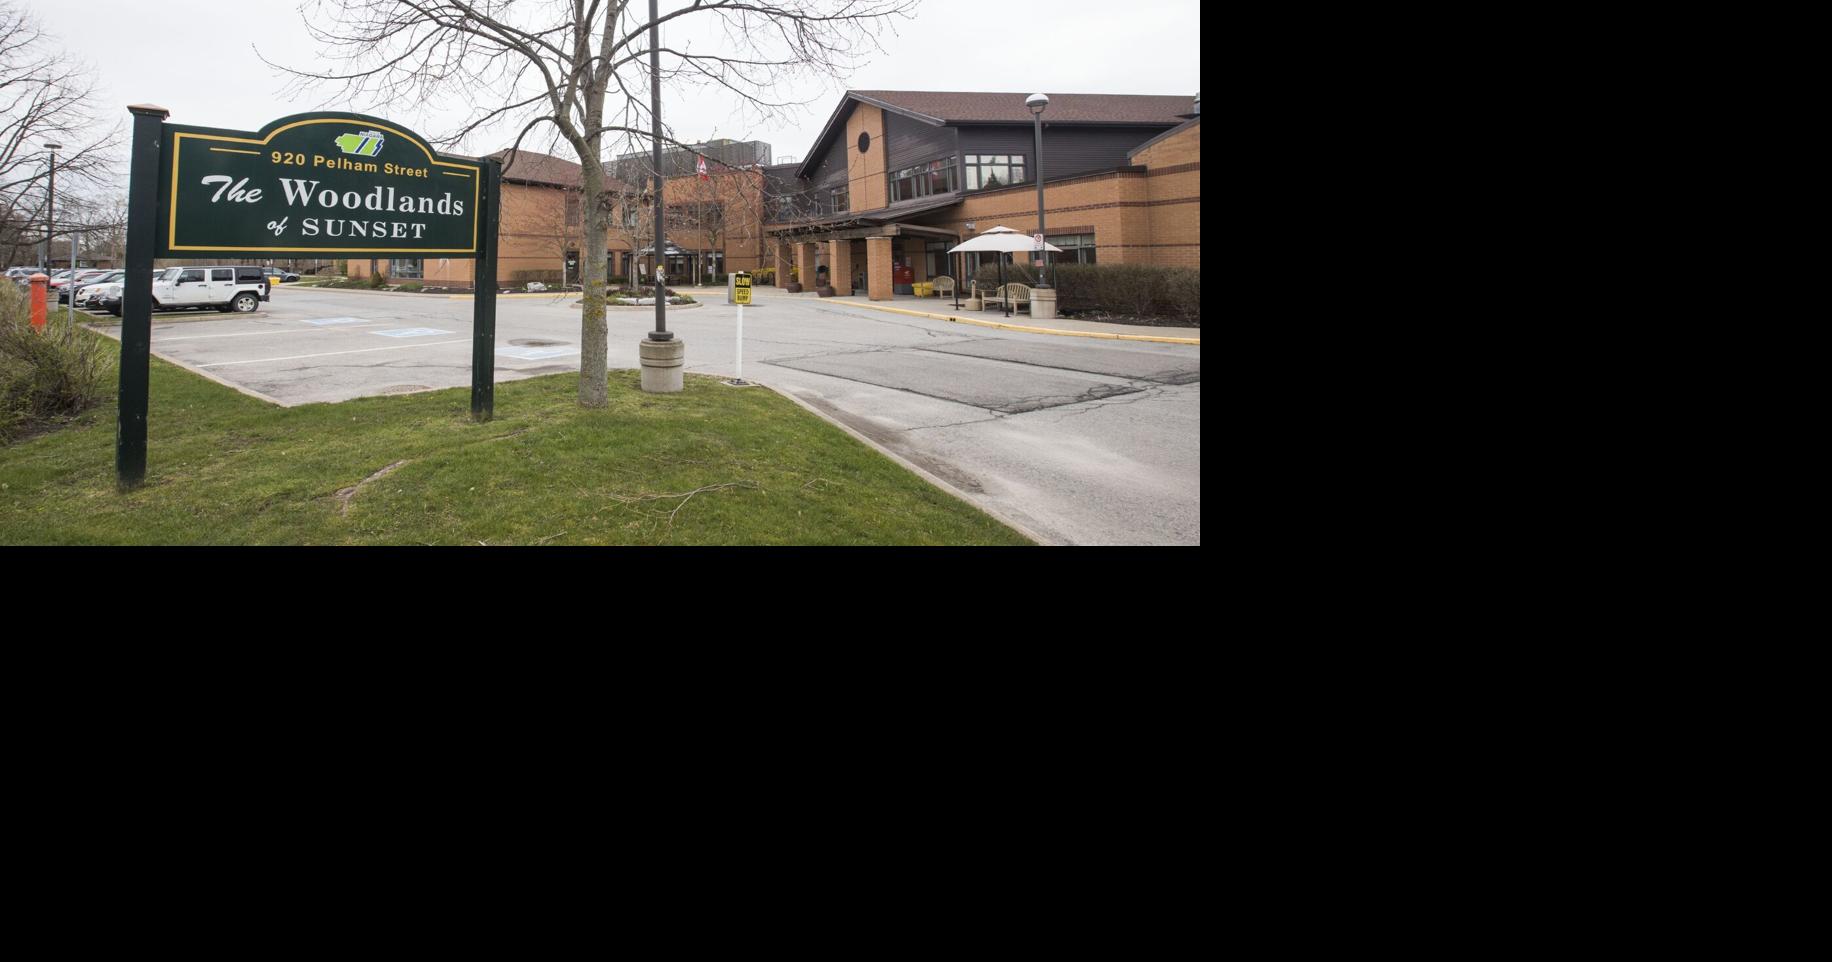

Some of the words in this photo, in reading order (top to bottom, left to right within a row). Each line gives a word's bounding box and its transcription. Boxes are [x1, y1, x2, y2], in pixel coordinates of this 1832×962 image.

[271, 151, 306, 166] 920
[313, 155, 378, 173] Pelham
[384, 163, 428, 178] Street
[201, 175, 263, 204] The
[279, 178, 464, 216] Woodlands
[267, 216, 288, 236] of
[302, 217, 426, 239] SUNSET
[735, 277, 750, 286] SLOW
